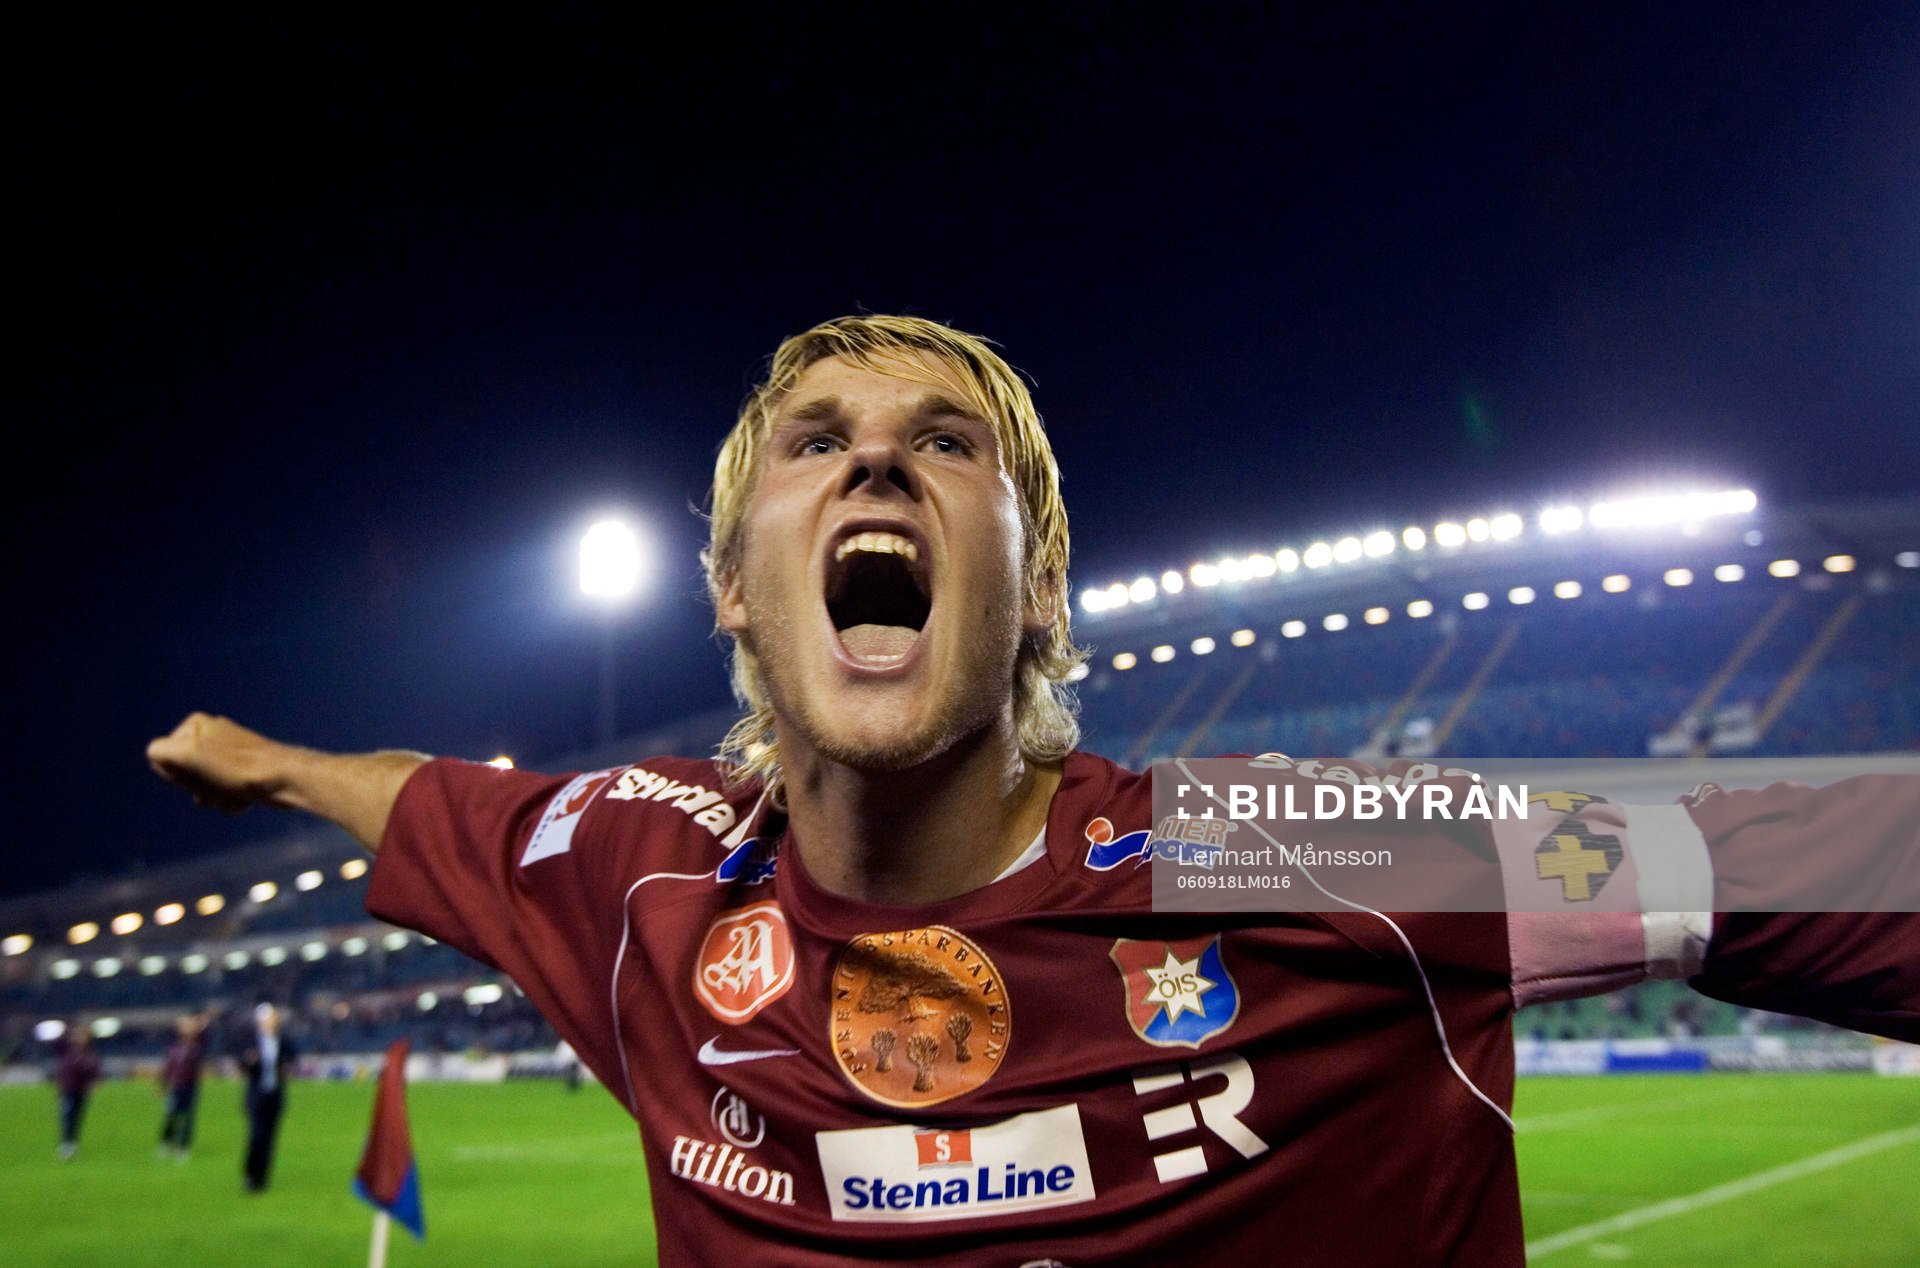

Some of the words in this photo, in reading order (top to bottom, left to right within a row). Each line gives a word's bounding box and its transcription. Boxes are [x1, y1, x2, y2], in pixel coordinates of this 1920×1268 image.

[1158, 973, 1198, 999] ÖIS
[935, 1134, 951, 1161] S
[671, 1135, 796, 1206] Hilton
[843, 1176, 969, 1210] Stena
[977, 1162, 1075, 1202] Line
